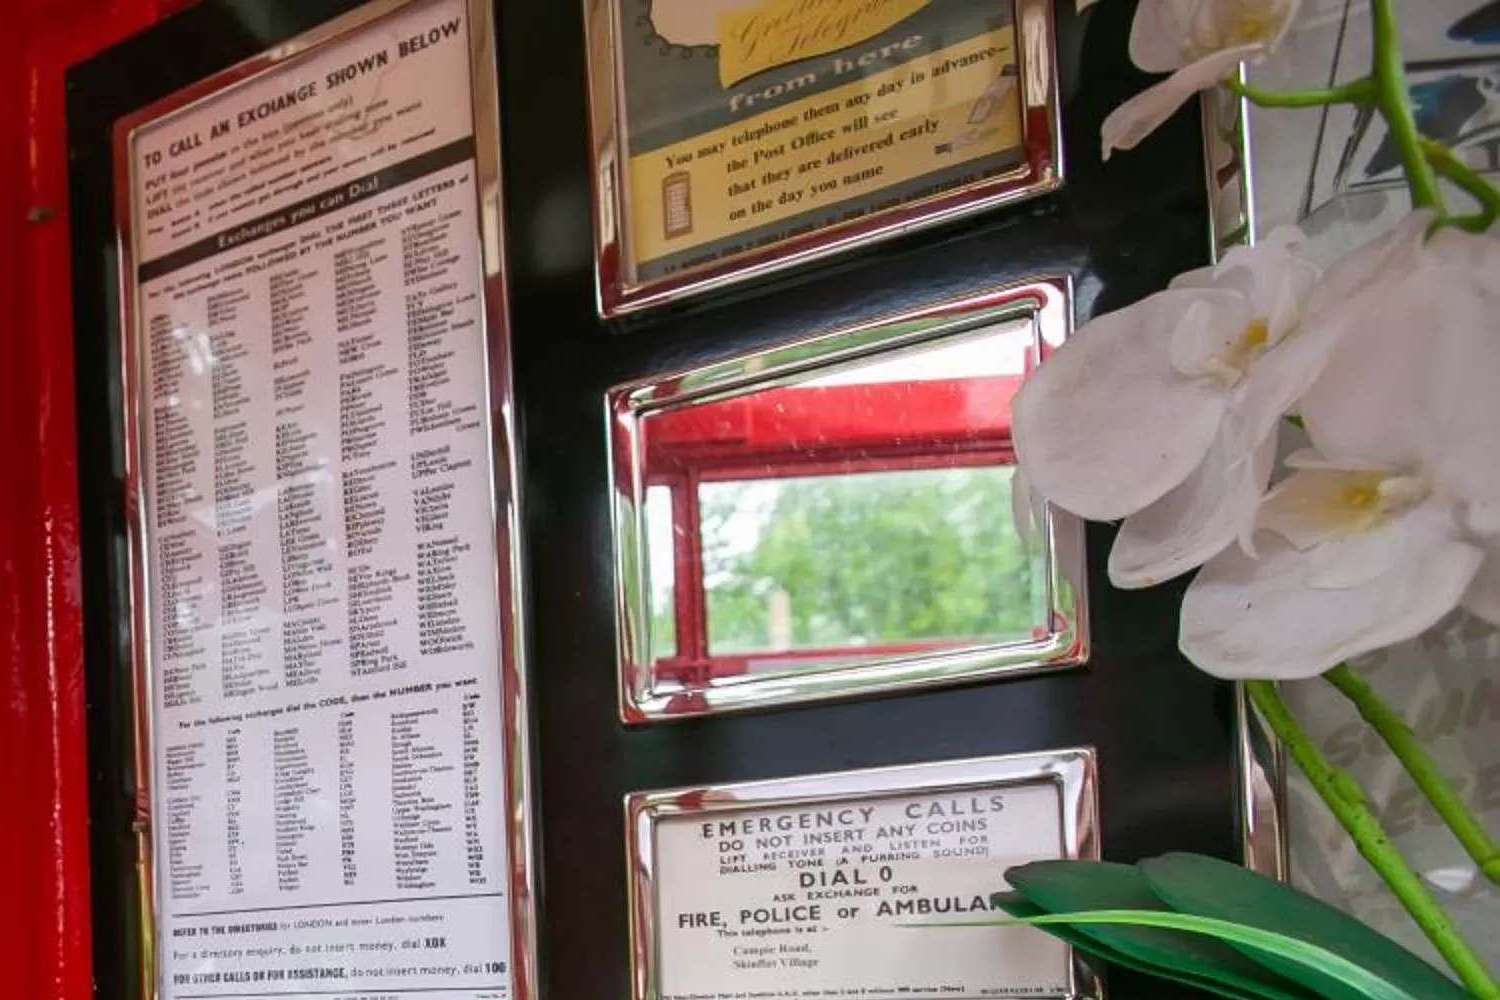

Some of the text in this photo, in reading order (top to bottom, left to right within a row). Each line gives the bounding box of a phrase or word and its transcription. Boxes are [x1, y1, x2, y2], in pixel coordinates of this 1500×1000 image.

[729, 35, 924, 112] from here
[144, 149, 162, 169] TO
[168, 132, 203, 158] CALL
[209, 119, 231, 140] AN
[325, 49, 388, 89] SHOWN
[398, 17, 460, 58] BELOW
[665, 149, 693, 170] You
[697, 141, 726, 160] may
[731, 115, 799, 147] telephone
[803, 102, 840, 122] them
[845, 93, 871, 109] any
[876, 76, 904, 97] day
[910, 69, 925, 85] in
[726, 108, 899, 173] the Post Office will see
[728, 116, 940, 197] that they are delivered early
[349, 176, 378, 198] Dial
[729, 164, 884, 221] on the day you name
[389, 682, 433, 696] NUMBER
[702, 795, 1005, 838] EMERGENCY CALLS
[719, 818, 988, 852] DO NOT INSERT ANY COINS
[720, 835, 988, 865] LIFT RECEIVER AND LISTEN FOR
[720, 863, 777, 875] DIALLING
[788, 858, 824, 868] TONE
[861, 852, 920, 863] PURRING
[800, 868, 867, 888] DIAL
[773, 885, 918, 903] ASK EXCHANGE FOR
[293, 919, 332, 929] LONDON
[678, 895, 997, 929] FIRE, POLICE or AMBULA
[325, 942, 355, 952] insert
[359, 942, 397, 952] money,
[401, 939, 420, 949] dial
[717, 929, 738, 938] This
[741, 927, 791, 937] telephone
[173, 973, 190, 984] FOR
[223, 972, 250, 982] CALLS
[267, 969, 284, 981] FOR
[386, 967, 417, 976] insert
[420, 965, 460, 977] money,
[463, 964, 482, 974] dial
